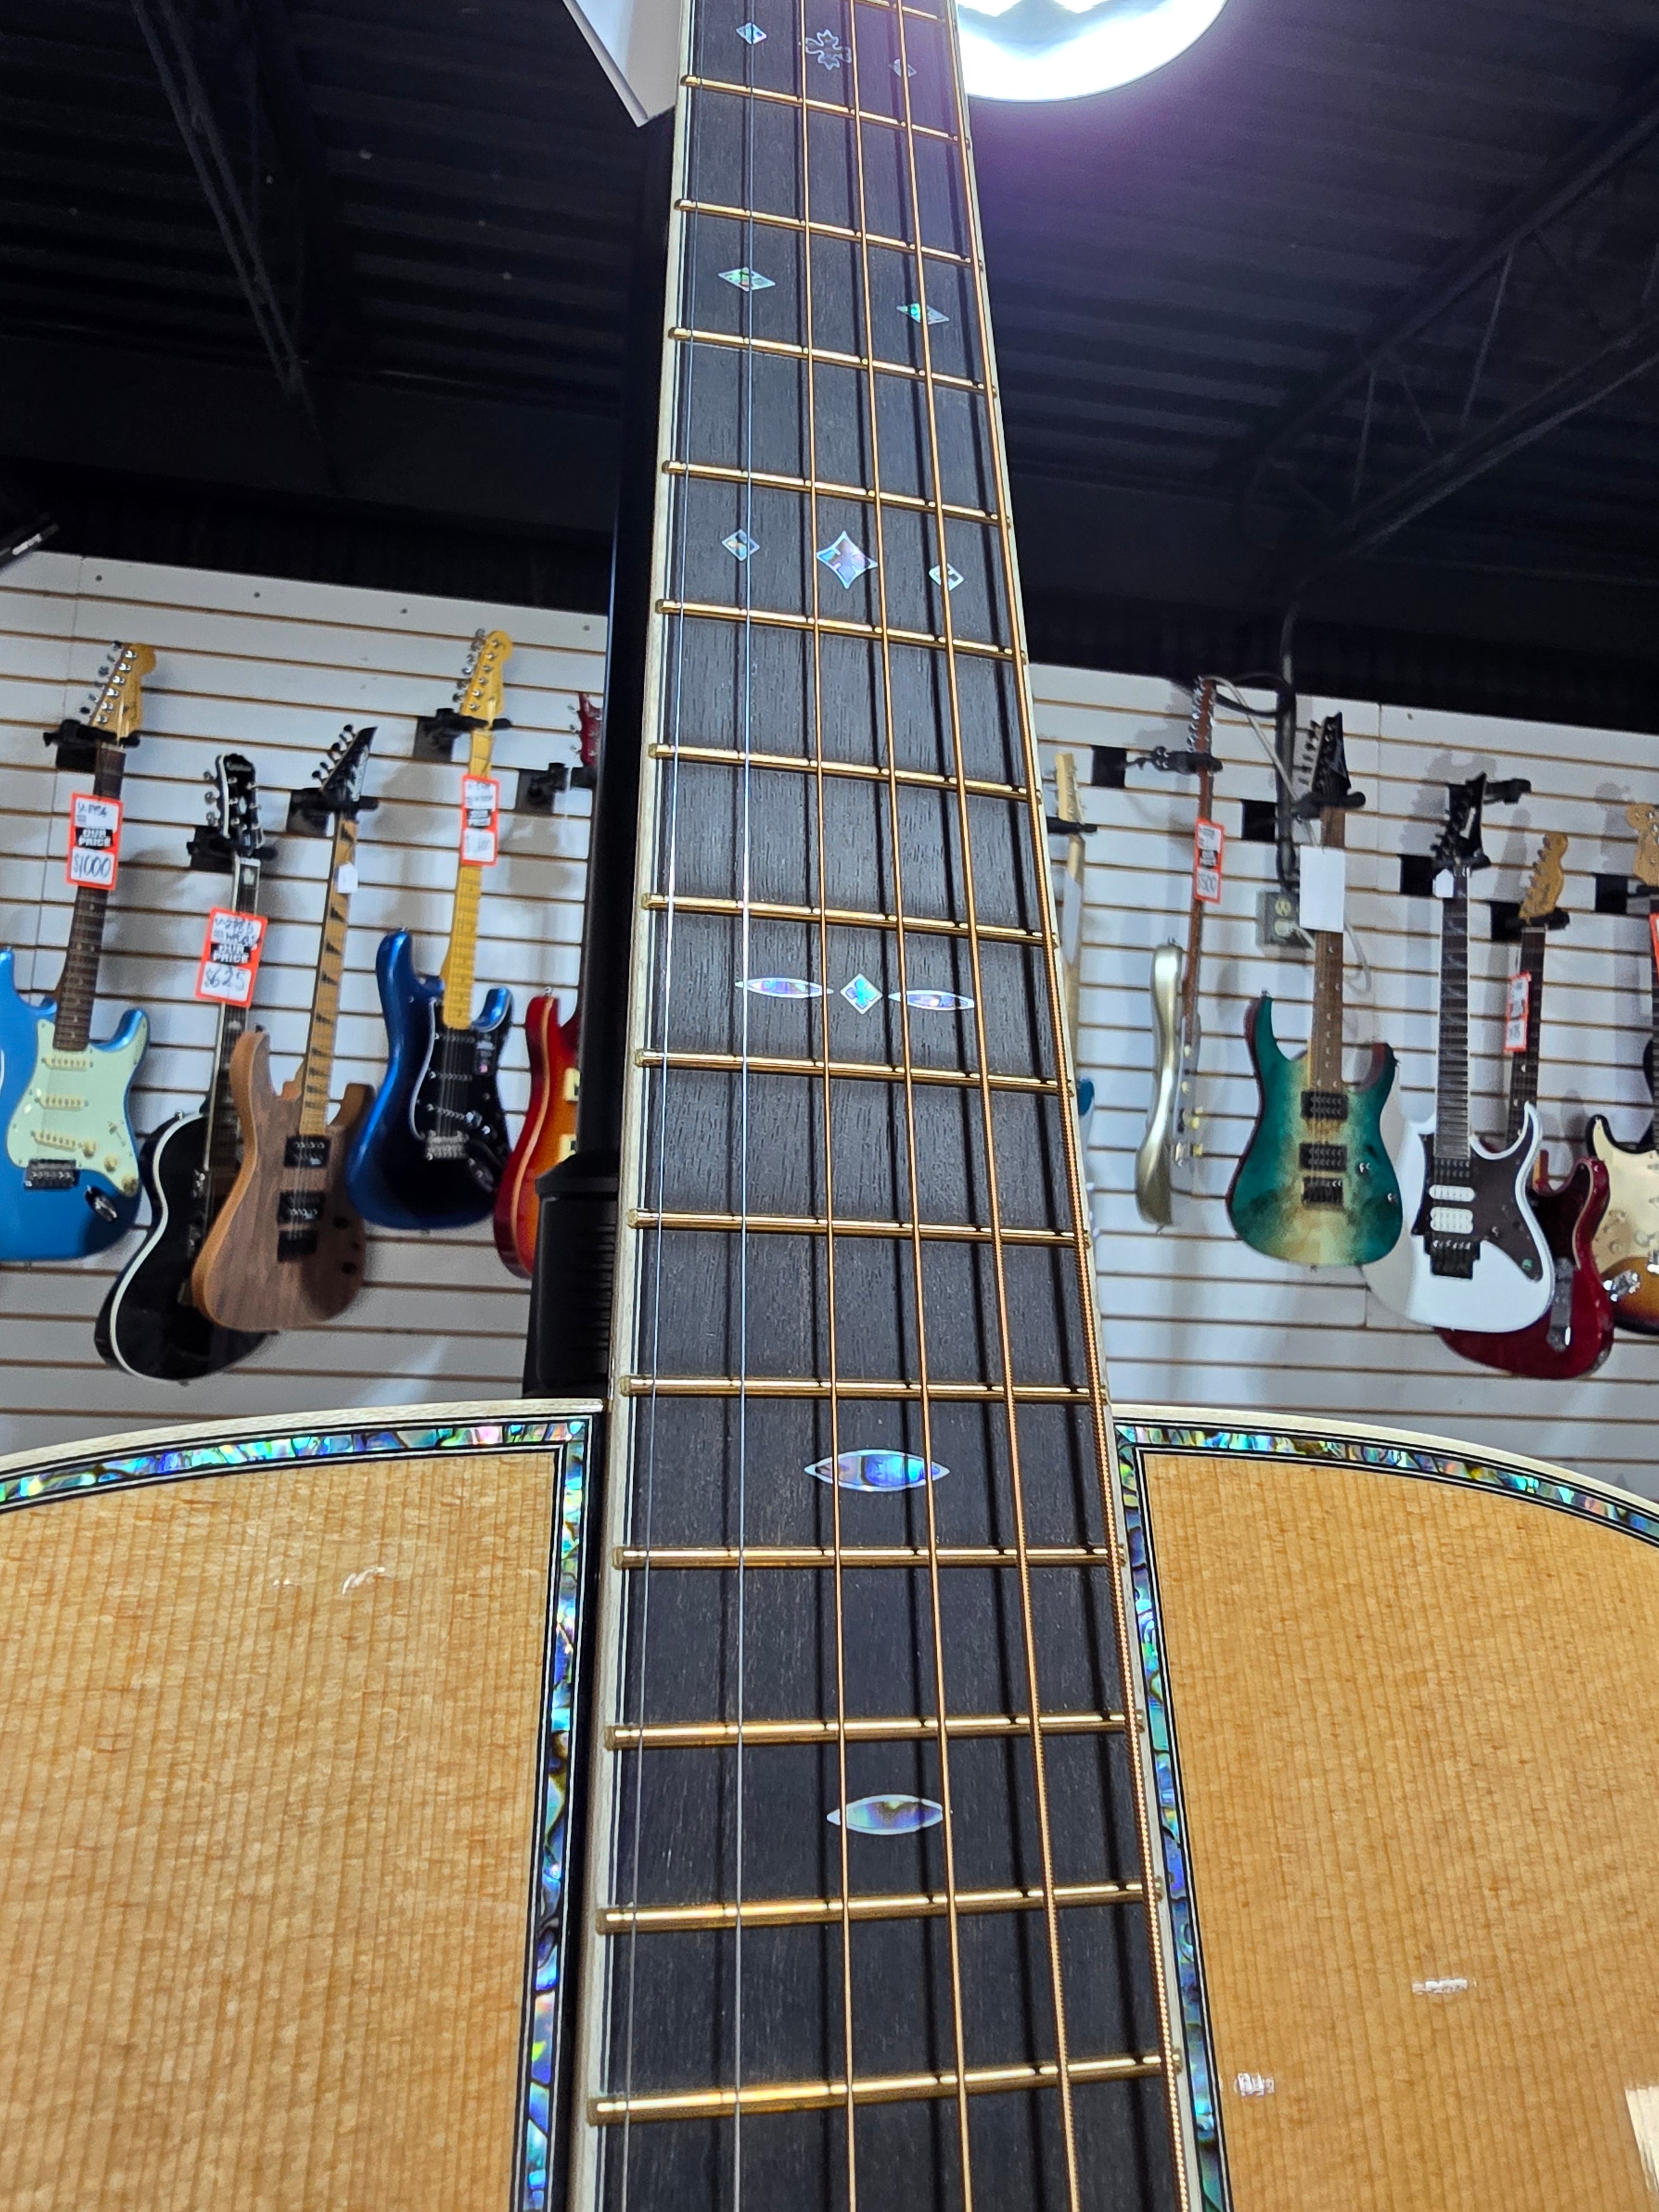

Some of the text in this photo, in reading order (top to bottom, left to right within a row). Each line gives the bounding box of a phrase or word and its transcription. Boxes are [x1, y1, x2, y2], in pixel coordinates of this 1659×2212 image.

[78, 835, 111, 847] PRICE
[73, 852, 111, 878] $1000
[204, 967, 246, 992] $625
